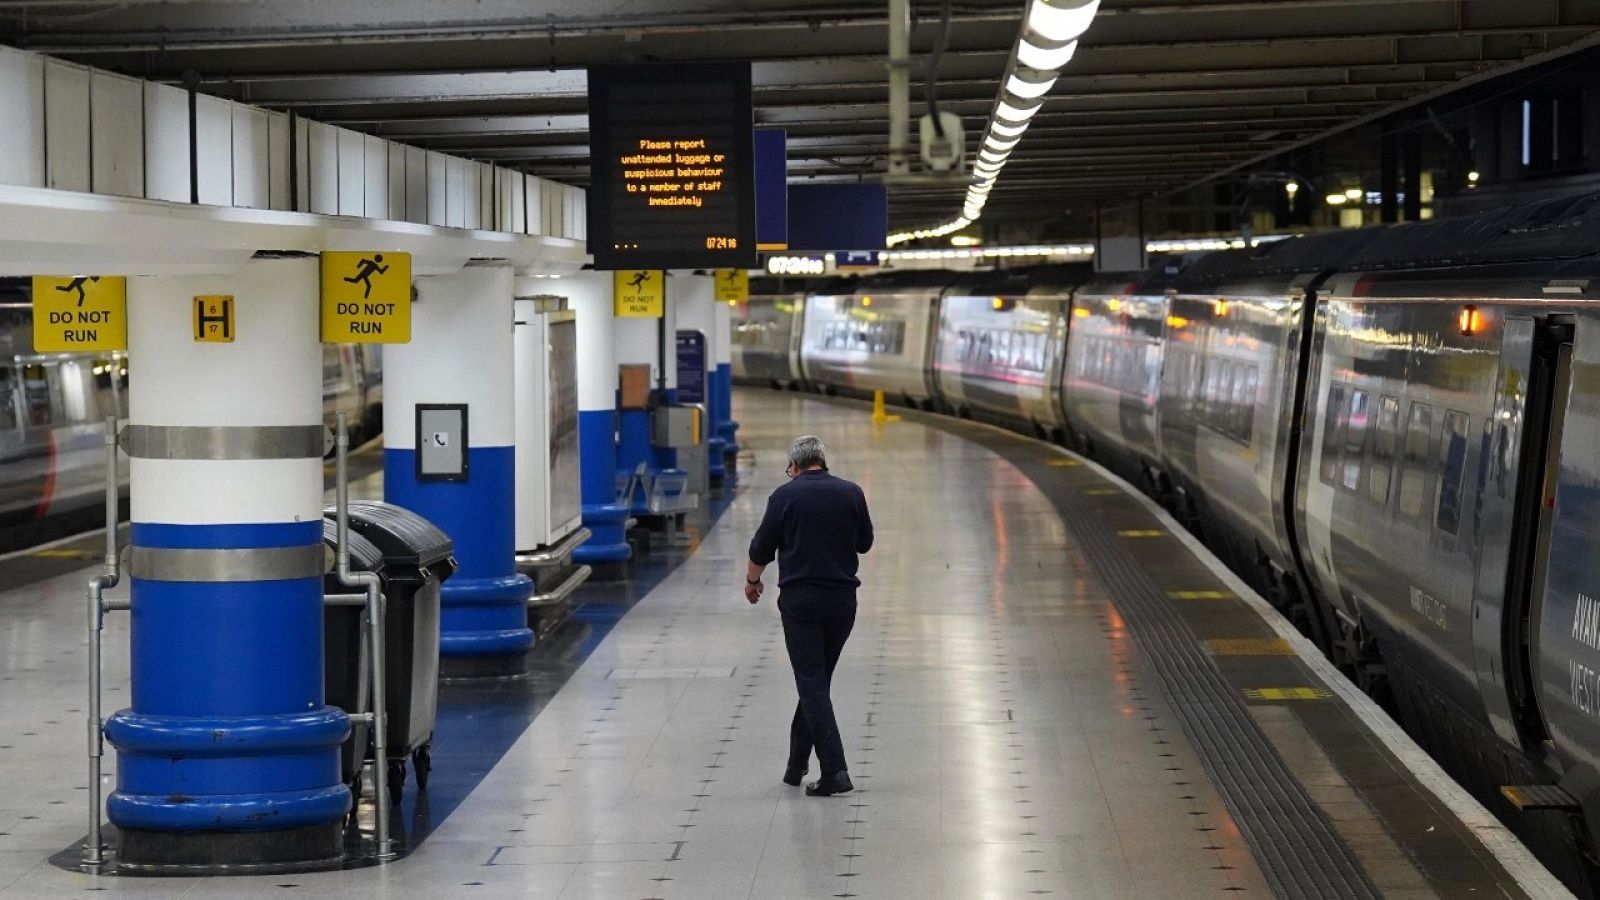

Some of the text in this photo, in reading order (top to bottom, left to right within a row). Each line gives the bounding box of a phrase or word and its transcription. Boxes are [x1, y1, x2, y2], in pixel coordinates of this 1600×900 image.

[639, 139, 706, 151] Please report
[620, 153, 726, 166] unattended luggage or
[624, 168, 724, 180] suspicious behaviour
[626, 181, 722, 193] to a member of staff
[648, 195, 703, 208] immediately
[623, 295, 654, 304] DO NOT
[209, 305, 217, 315] 6
[336, 302, 396, 316] DO NOT
[49, 310, 111, 324] DO NOT
[198, 300, 230, 339] H
[208, 324, 219, 334] 17
[349, 321, 382, 334] RUN
[64, 329, 98, 342] RUN
